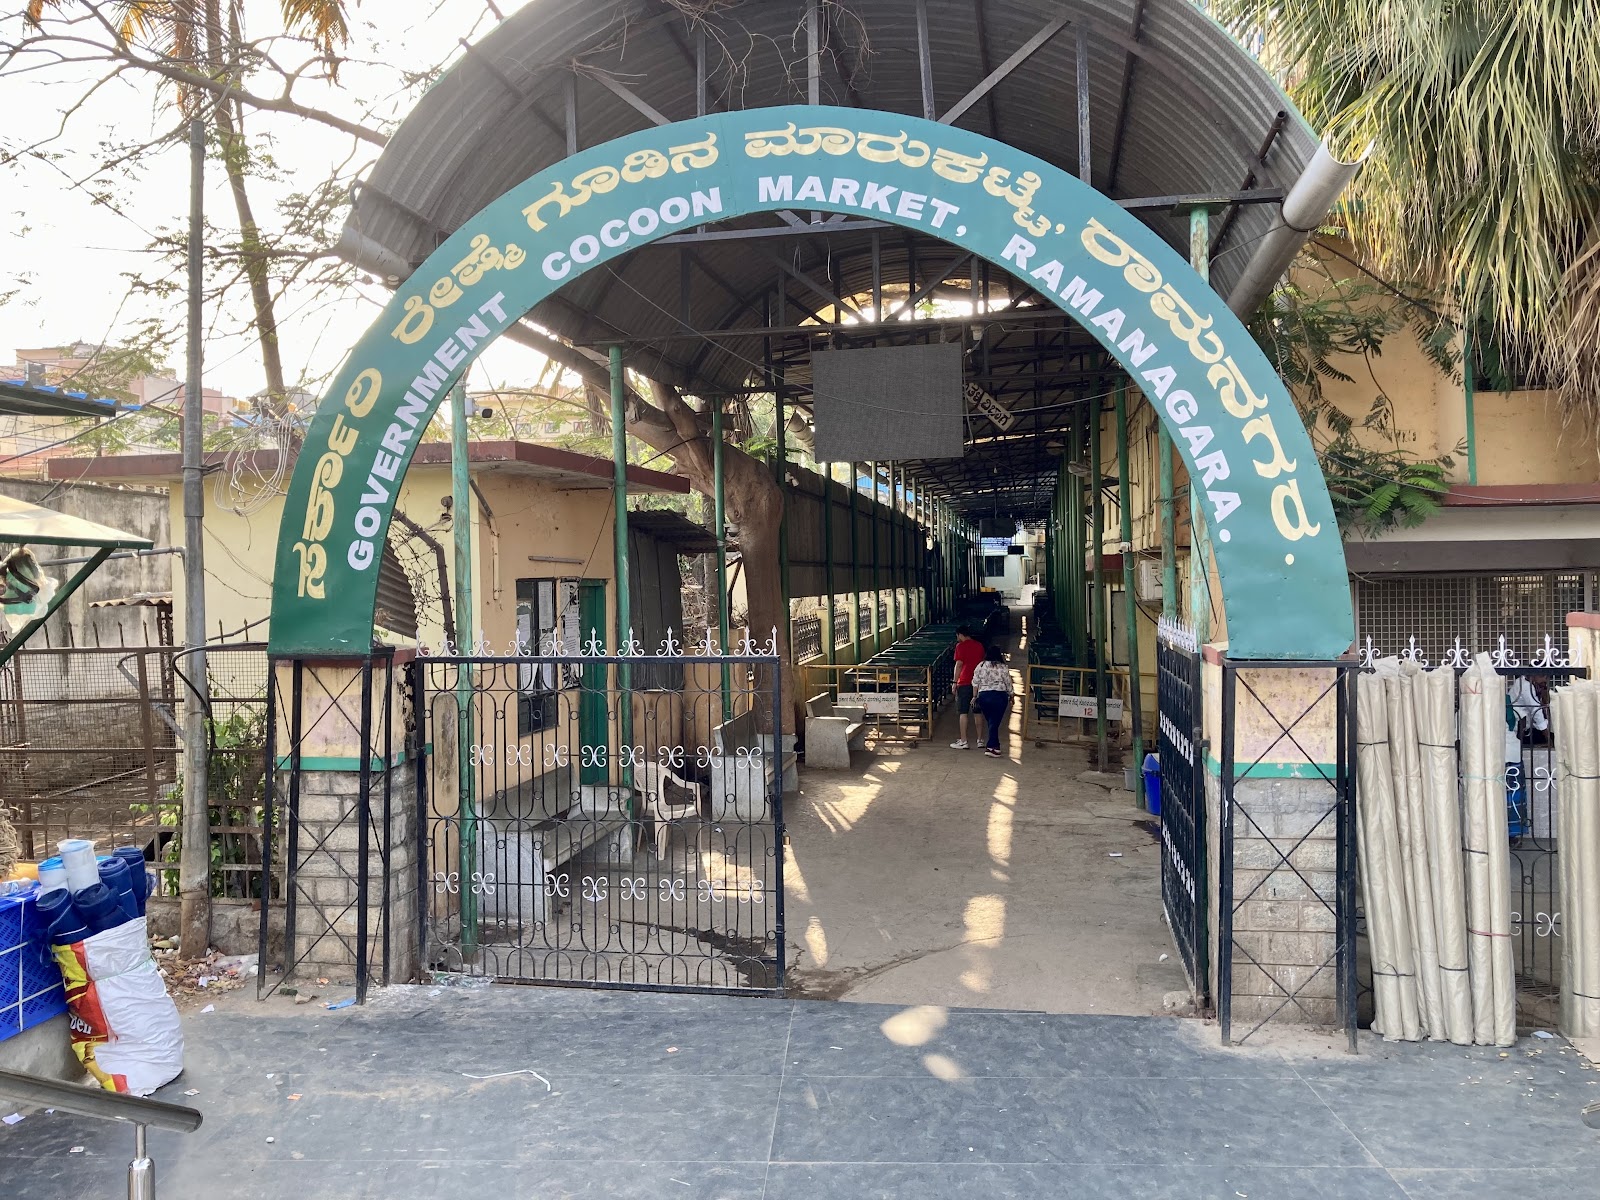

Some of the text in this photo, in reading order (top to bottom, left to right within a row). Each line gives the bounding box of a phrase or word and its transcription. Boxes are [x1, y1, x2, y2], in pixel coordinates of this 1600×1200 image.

[292, 367, 383, 599] ಸರ್ಕಾರಿ
[390, 233, 527, 345] ರೇಷ್ಮೆ
[521, 132, 719, 233] ಗೂಡಿನ
[347, 175, 1233, 570] GOVERNMENT COCOON MARKET, RAMANAGARA.
[1084, 707, 1093, 716] 12
